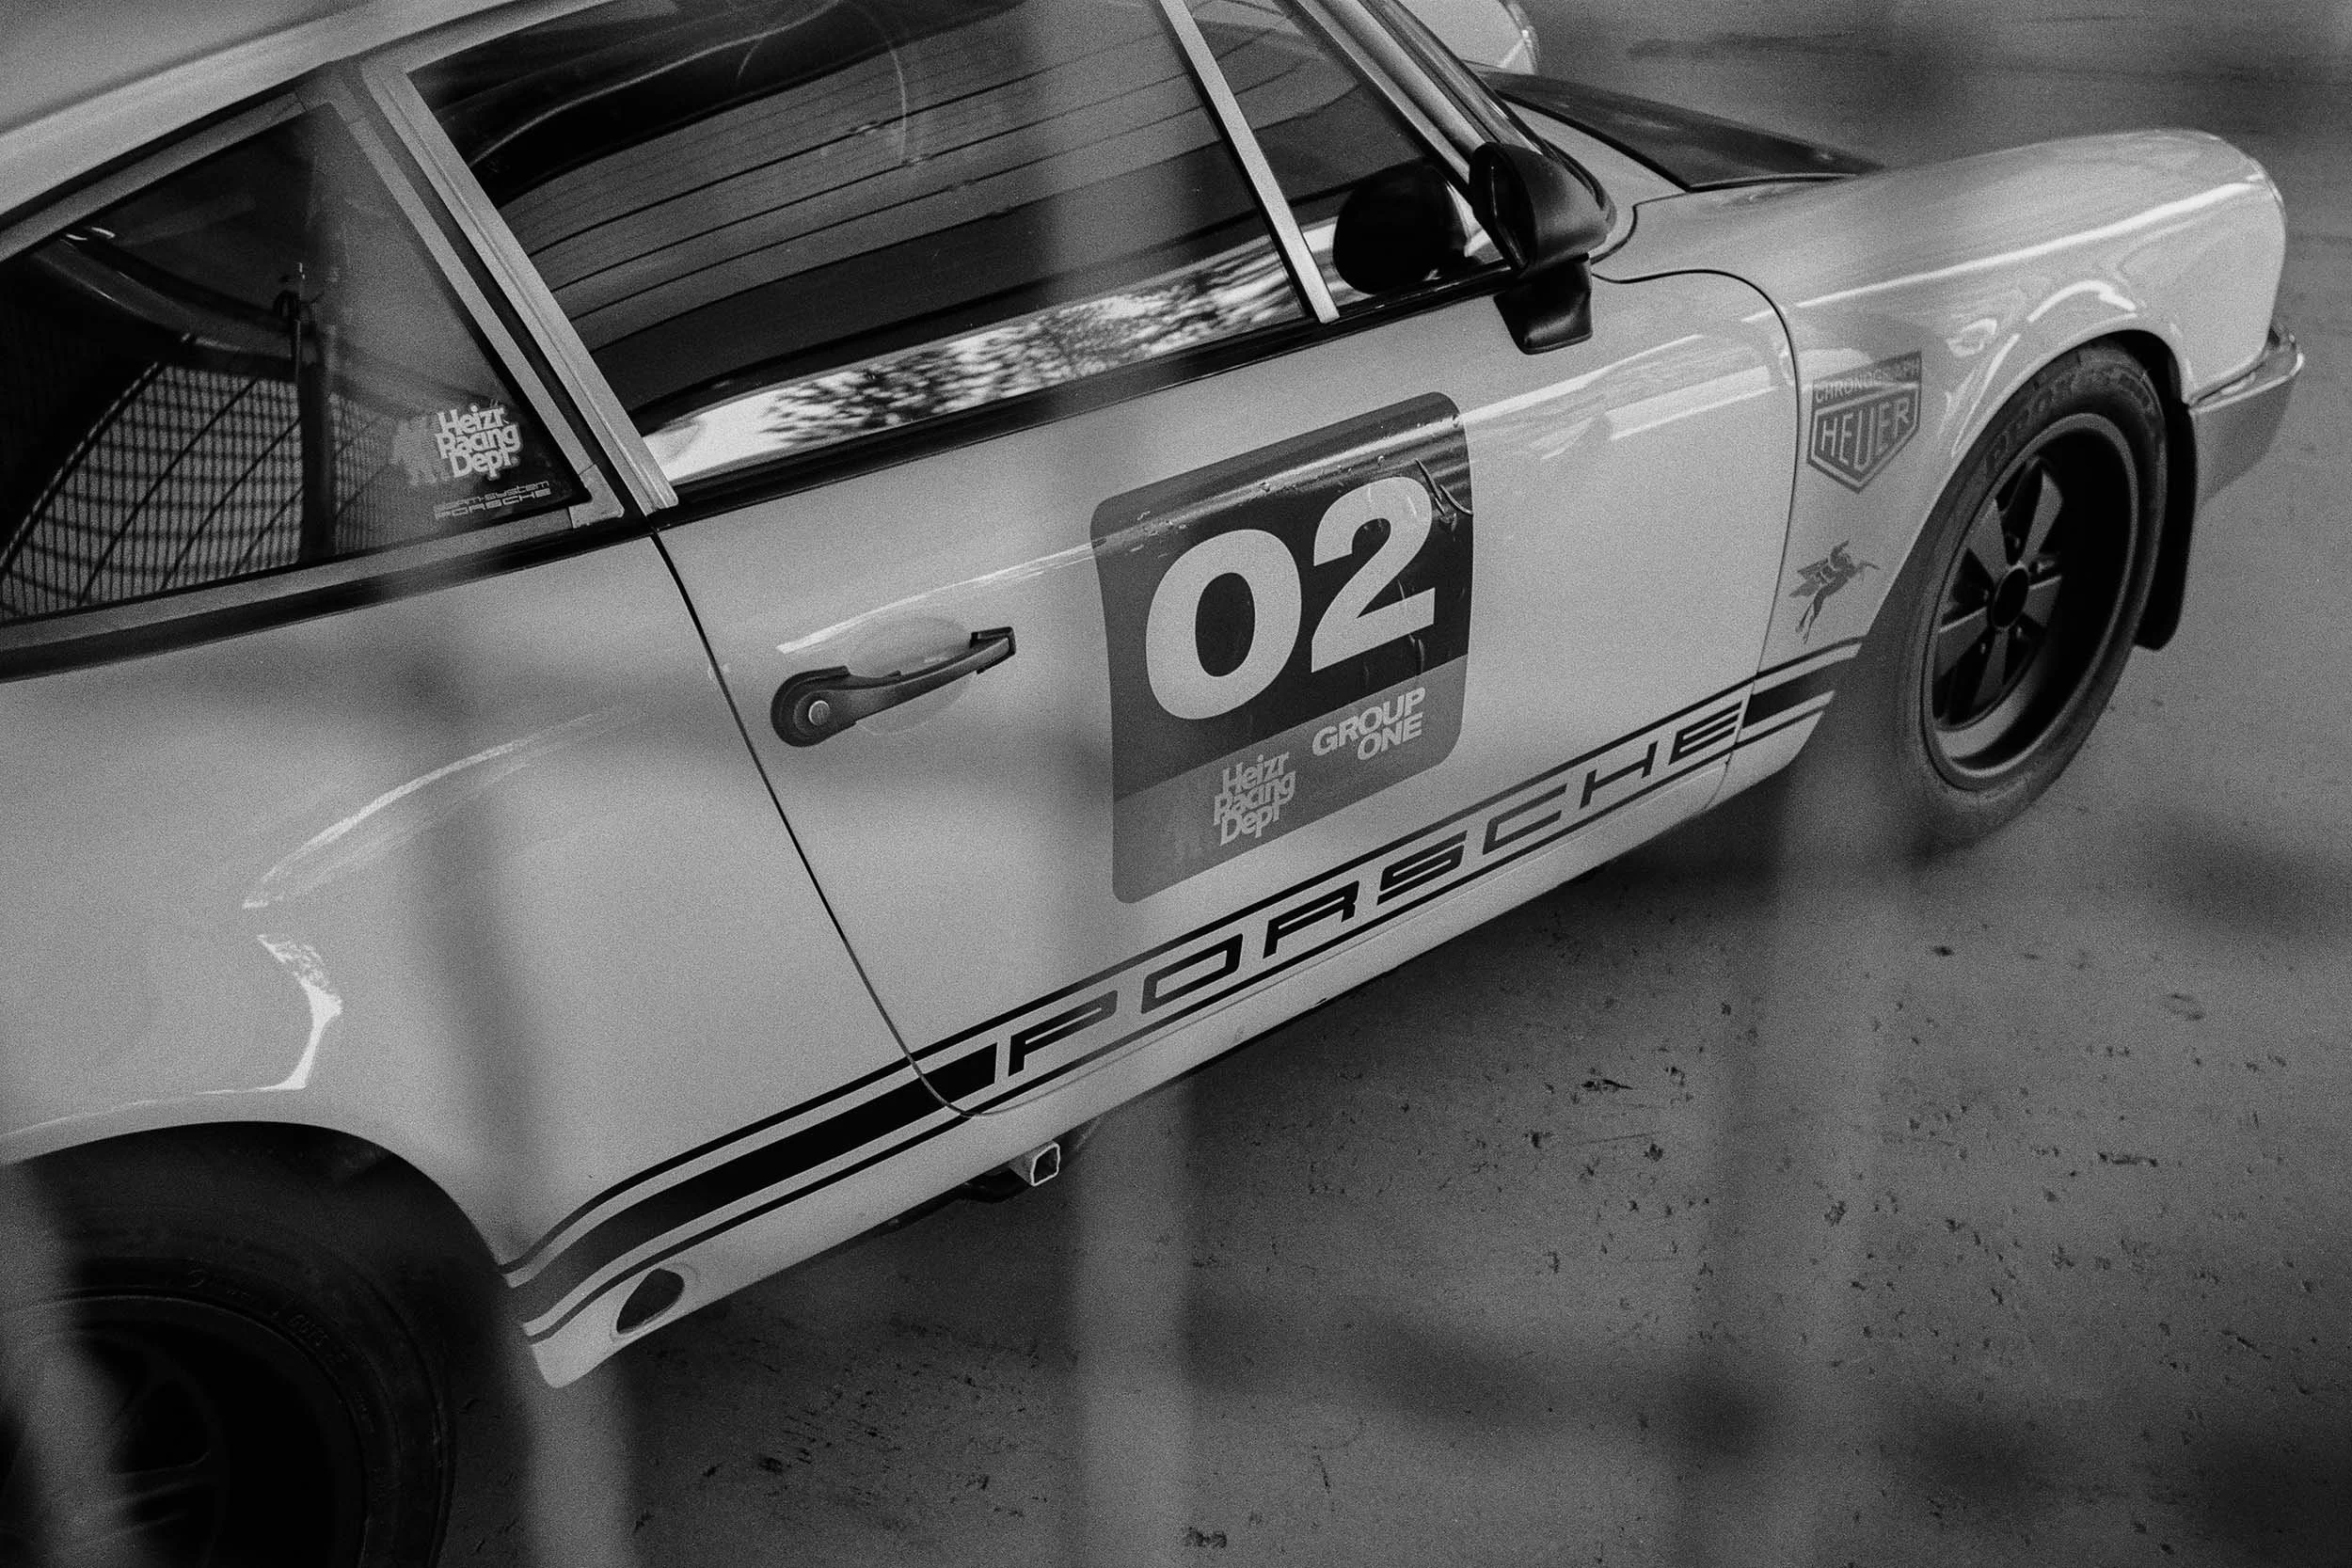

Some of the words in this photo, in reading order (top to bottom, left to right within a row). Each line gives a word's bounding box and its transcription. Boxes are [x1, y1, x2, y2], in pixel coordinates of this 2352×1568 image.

[435, 423, 519, 457] Racing
[437, 404, 504, 436] Heizr
[1820, 395, 1911, 471] HEUER
[433, 488, 551, 519] PORSCHE
[1146, 477, 1436, 721] 02
[1311, 687, 1426, 756] GROUP
[1357, 714, 1423, 761] ONE
[1214, 770, 1296, 826] Racing
[1221, 752, 1290, 796] Heizr
[1009, 699, 1745, 1078] PORSCHE
